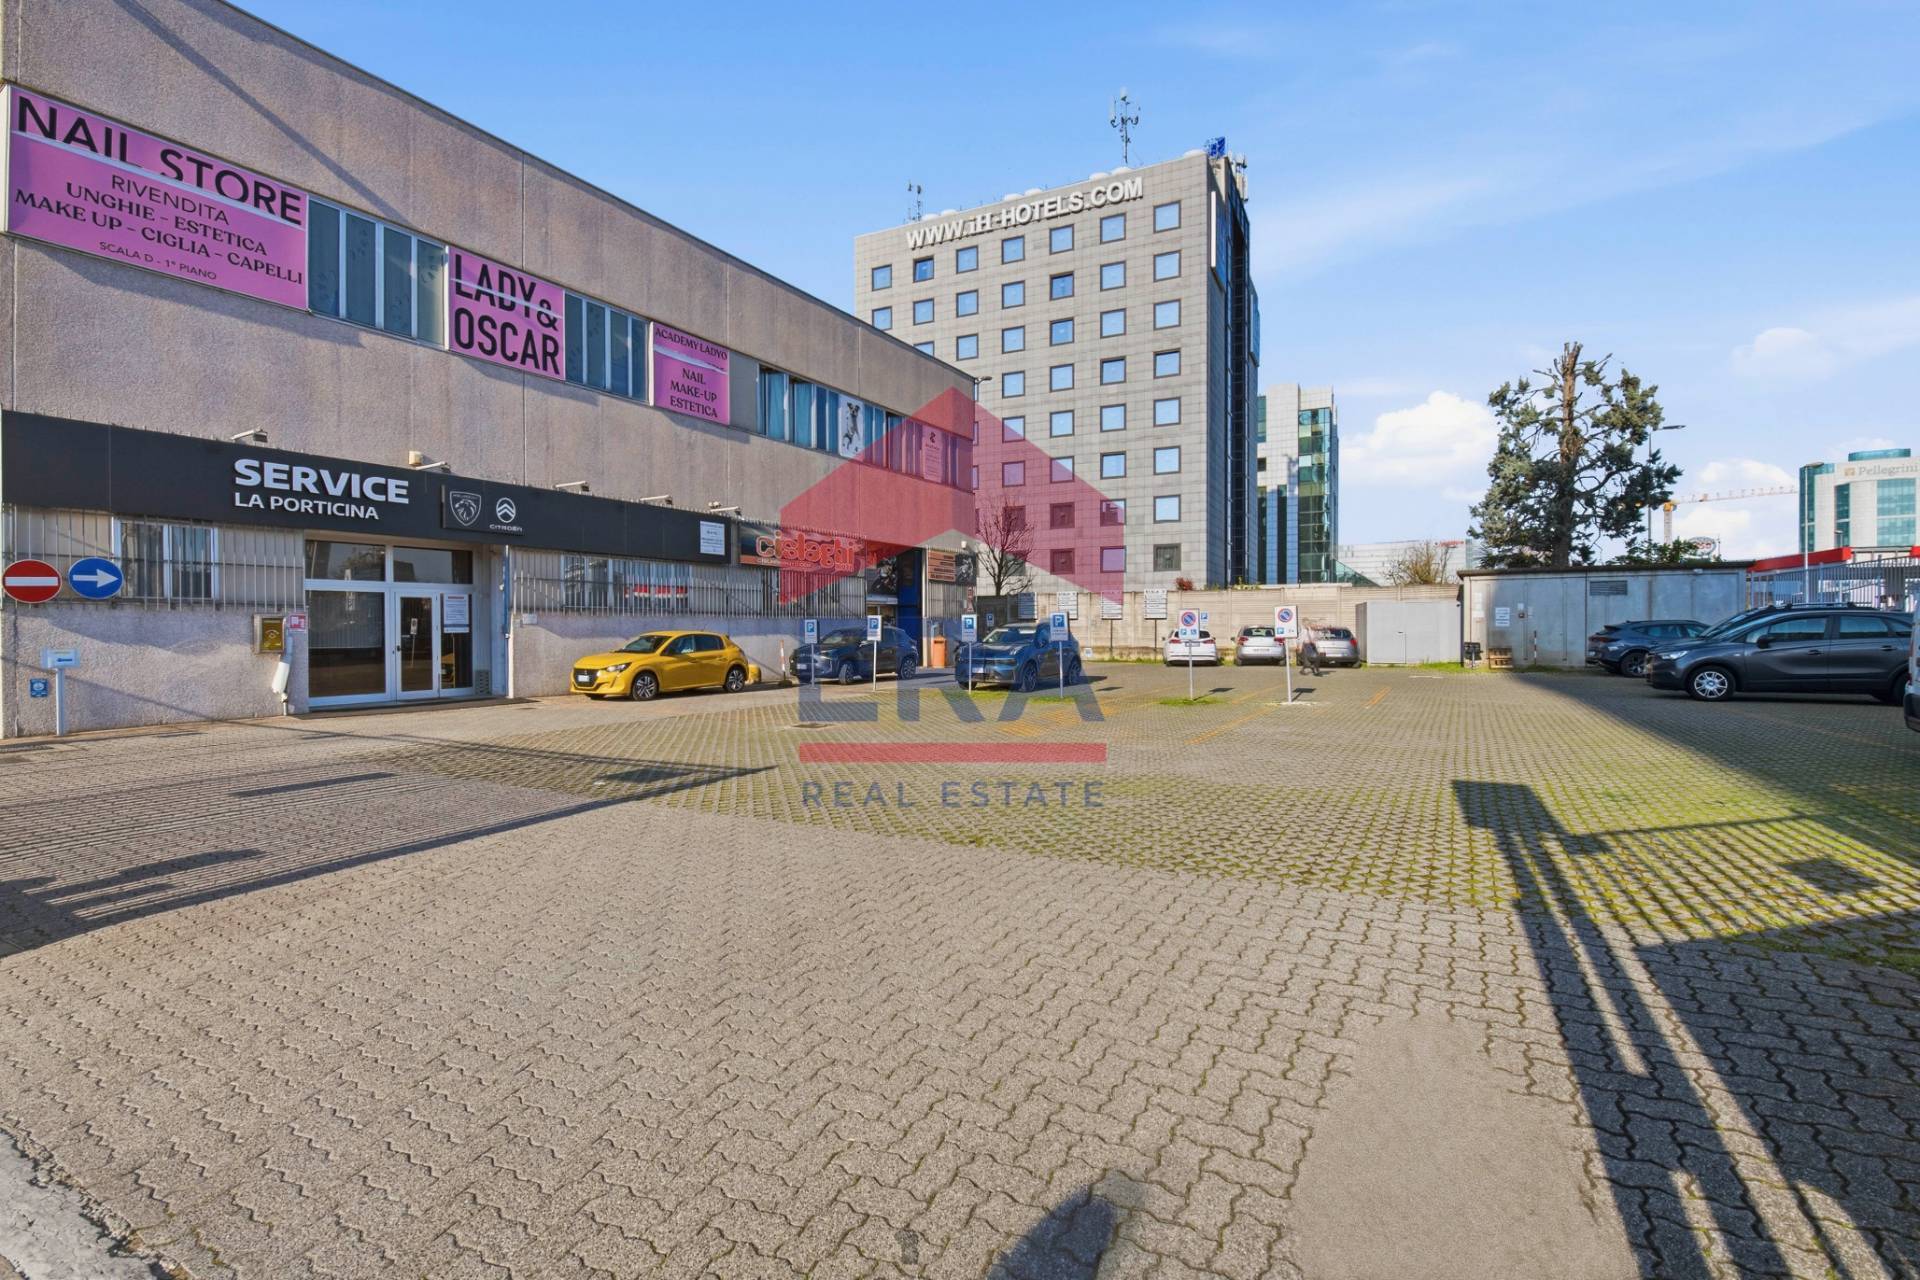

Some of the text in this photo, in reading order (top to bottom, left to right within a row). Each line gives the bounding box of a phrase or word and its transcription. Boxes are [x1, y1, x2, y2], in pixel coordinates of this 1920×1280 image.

[18, 95, 302, 226] NAIL STORE
[66, 181, 156, 222] UNGHIE
[174, 215, 268, 257] ESTETICA
[111, 173, 230, 226] RIVENDITA
[15, 188, 87, 222] MAKE
[92, 210, 122, 231] UP
[141, 226, 211, 258] CIGLIA
[227, 251, 303, 286] CAPELLI
[99, 241, 141, 260] SCALA
[144, 253, 154, 263] D
[179, 262, 217, 280] PIANO
[454, 307, 560, 376] OSCAR
[655, 327, 698, 350] ACADEMY
[670, 380, 718, 403] MAKE-UP
[682, 367, 706, 385] NAIL
[670, 395, 718, 418] ESTETICA
[234, 458, 409, 504] SERVICE
[1858, 463, 1919, 477] Pellegrini
[234, 491, 379, 521] LA PORTICINA
